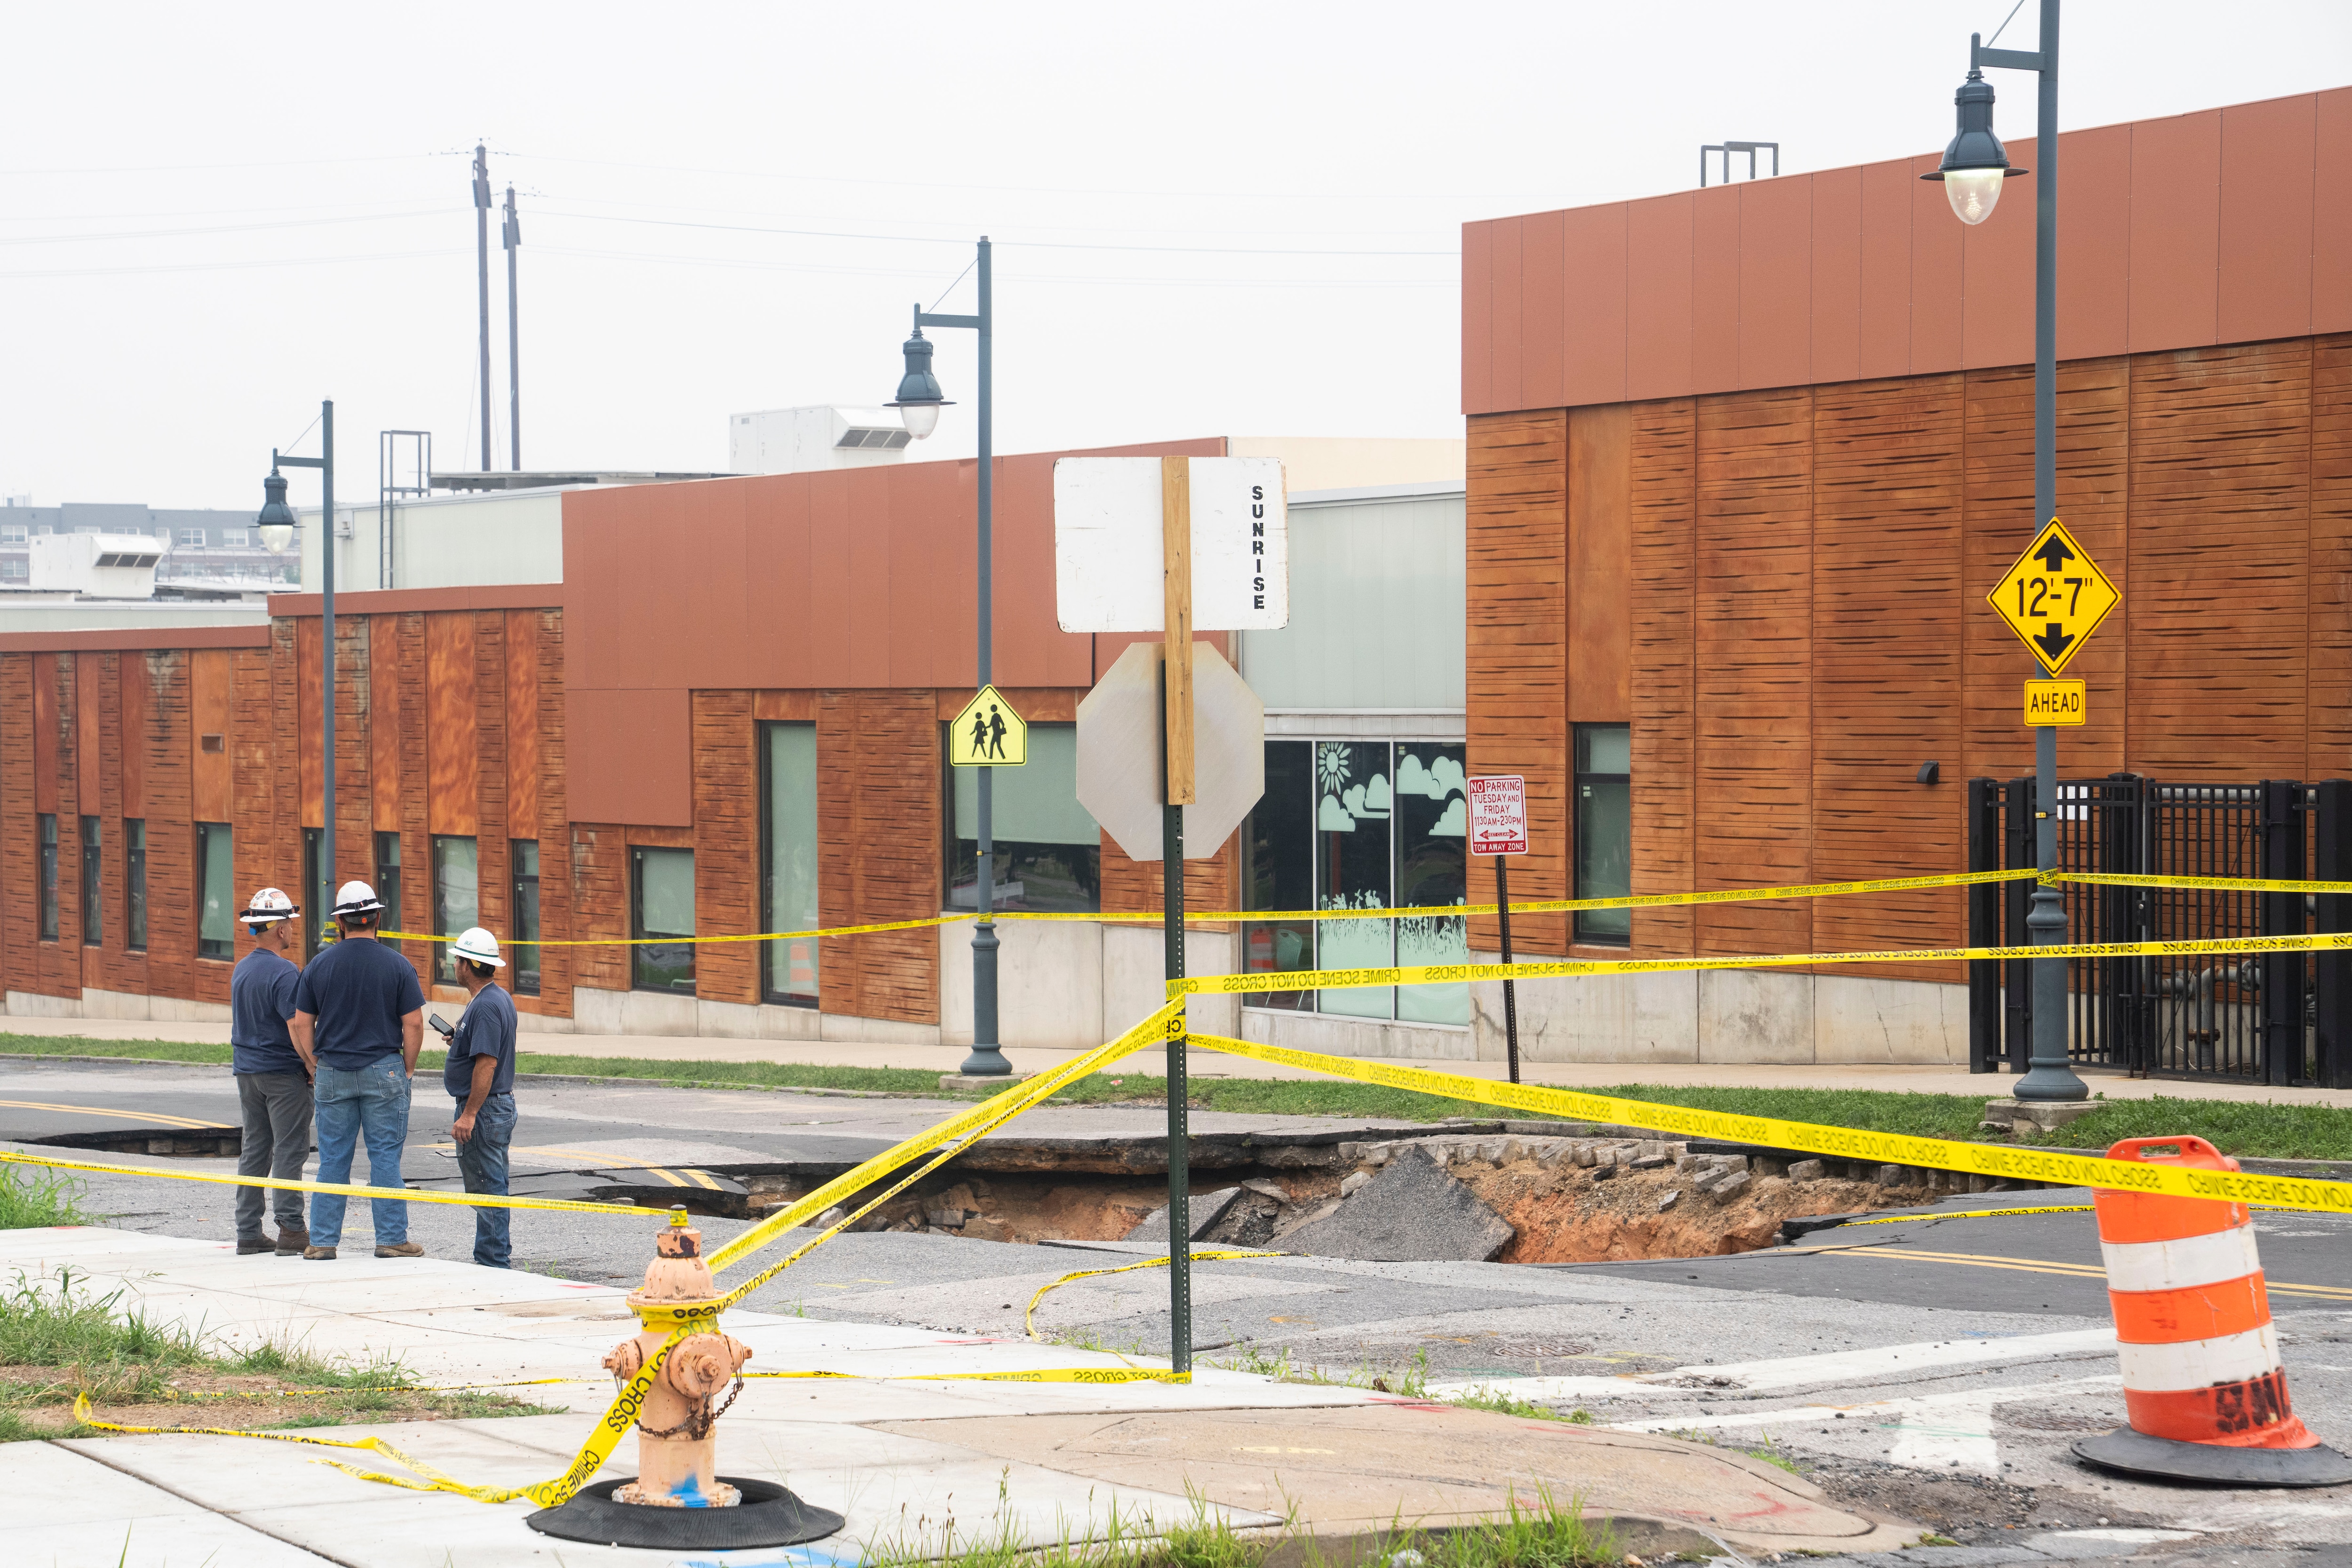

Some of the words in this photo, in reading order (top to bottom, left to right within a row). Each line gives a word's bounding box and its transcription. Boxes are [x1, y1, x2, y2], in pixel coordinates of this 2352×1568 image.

[1252, 486, 1264, 609] SUNRISE
[2017, 577, 2092, 616] 12'-7"
[2031, 693, 2079, 712] AHEAD
[1470, 782, 1483, 792] NO
[1486, 781, 1519, 791] PARKING
[1474, 794, 1506, 804] TUESDAY
[1485, 805, 1510, 814] FRIDAY
[2163, 942, 2199, 952] CROSS
[2201, 940, 2222, 951] NOT
[2226, 939, 2240, 951] DO
[2243, 938, 2277, 950] SCENE
[2280, 935, 2312, 949] CRIME
[2333, 935, 2352, 947] OSS
[608, 1377, 652, 1433] CROSS
[567, 1450, 600, 1495] CRIME
